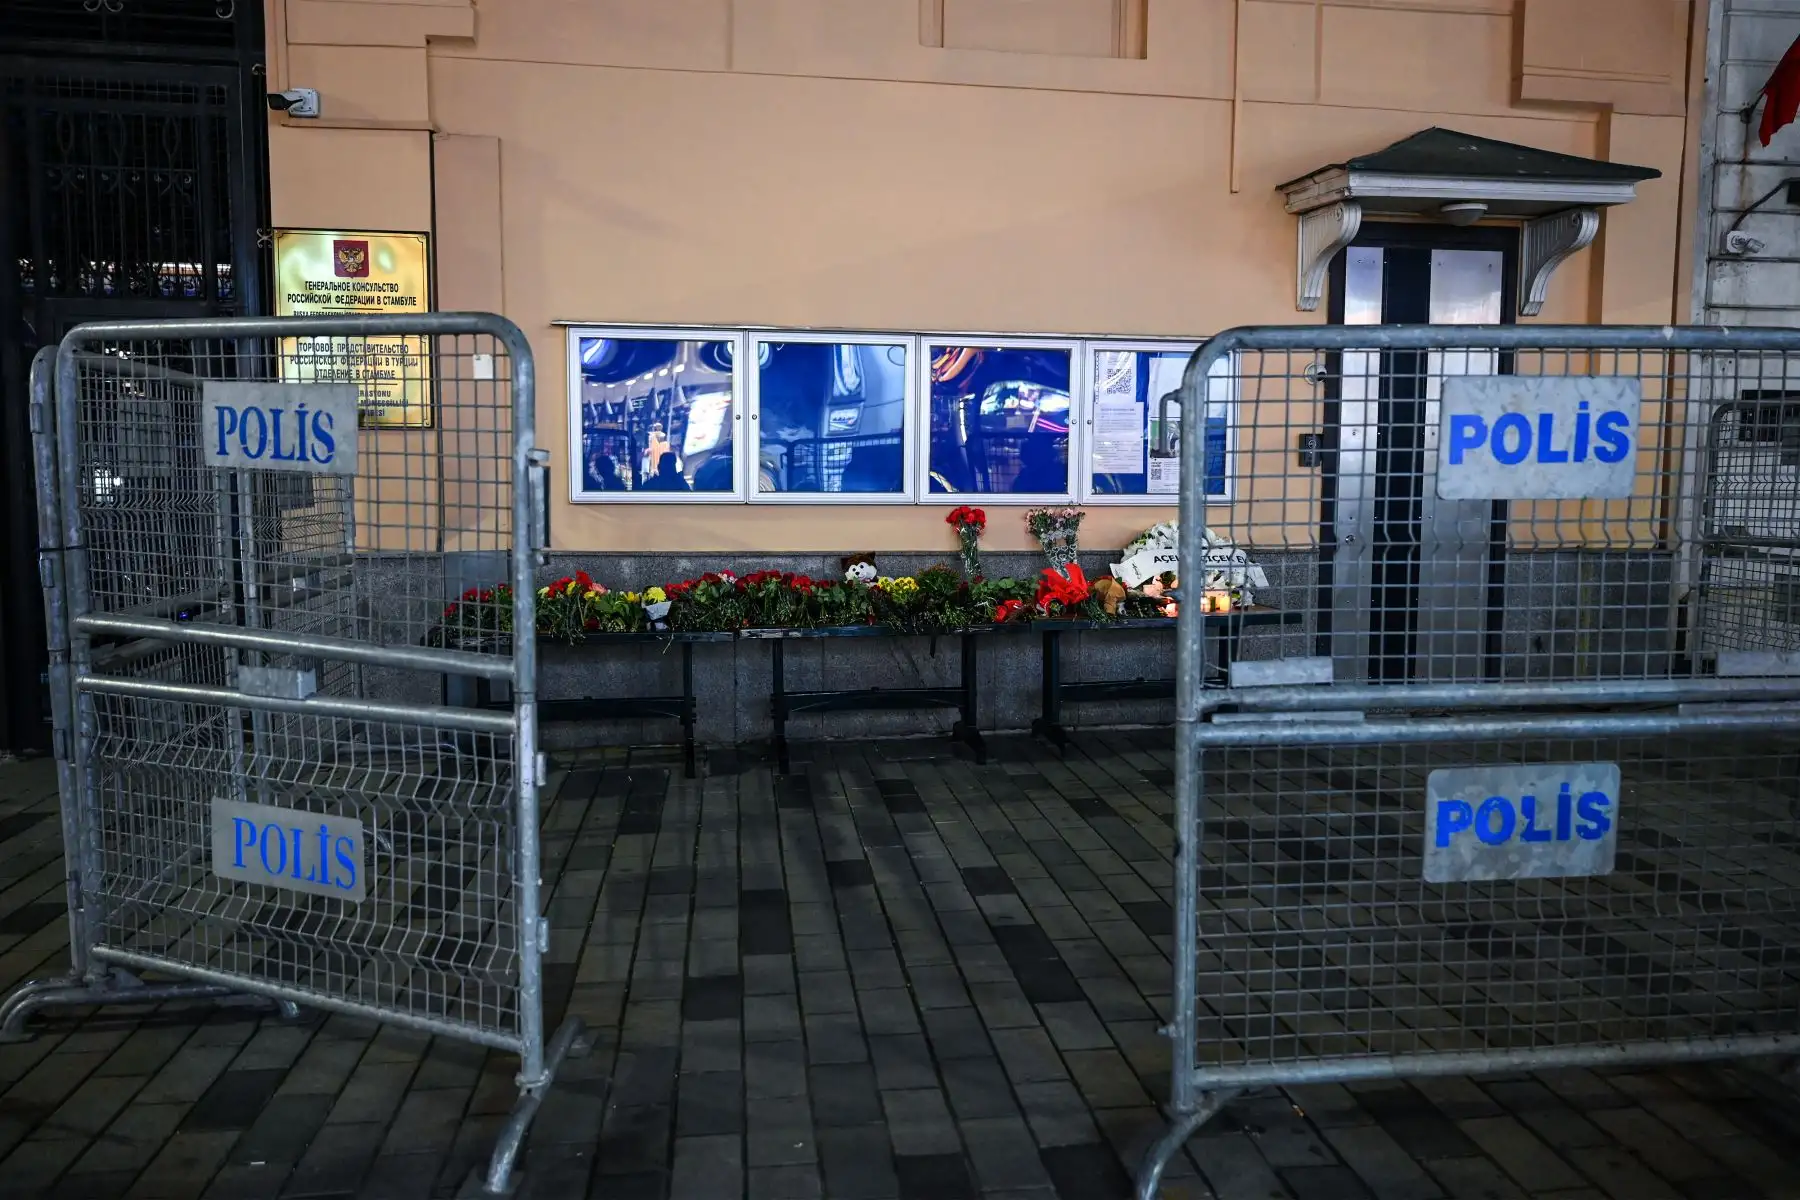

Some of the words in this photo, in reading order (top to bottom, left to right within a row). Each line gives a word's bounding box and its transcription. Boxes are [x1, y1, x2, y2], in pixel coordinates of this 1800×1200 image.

[287, 293, 331, 304] РОССИЙСКОЙ
[335, 295, 375, 306] ФЕДЕРАЦИИ
[376, 296, 382, 305] В
[383, 296, 417, 306] СТАМБУЛЕ
[305, 281, 350, 292] ГЕНЕРАЛЬНОЕ
[352, 282, 399, 293] КОНСУЛЬСТВО
[355, 370, 360, 379] В
[385, 357, 390, 366] В
[214, 403, 335, 464] POLİS
[1448, 400, 1630, 465] POLİS
[1435, 782, 1611, 848] POLİS
[232, 817, 356, 890] POLİS
